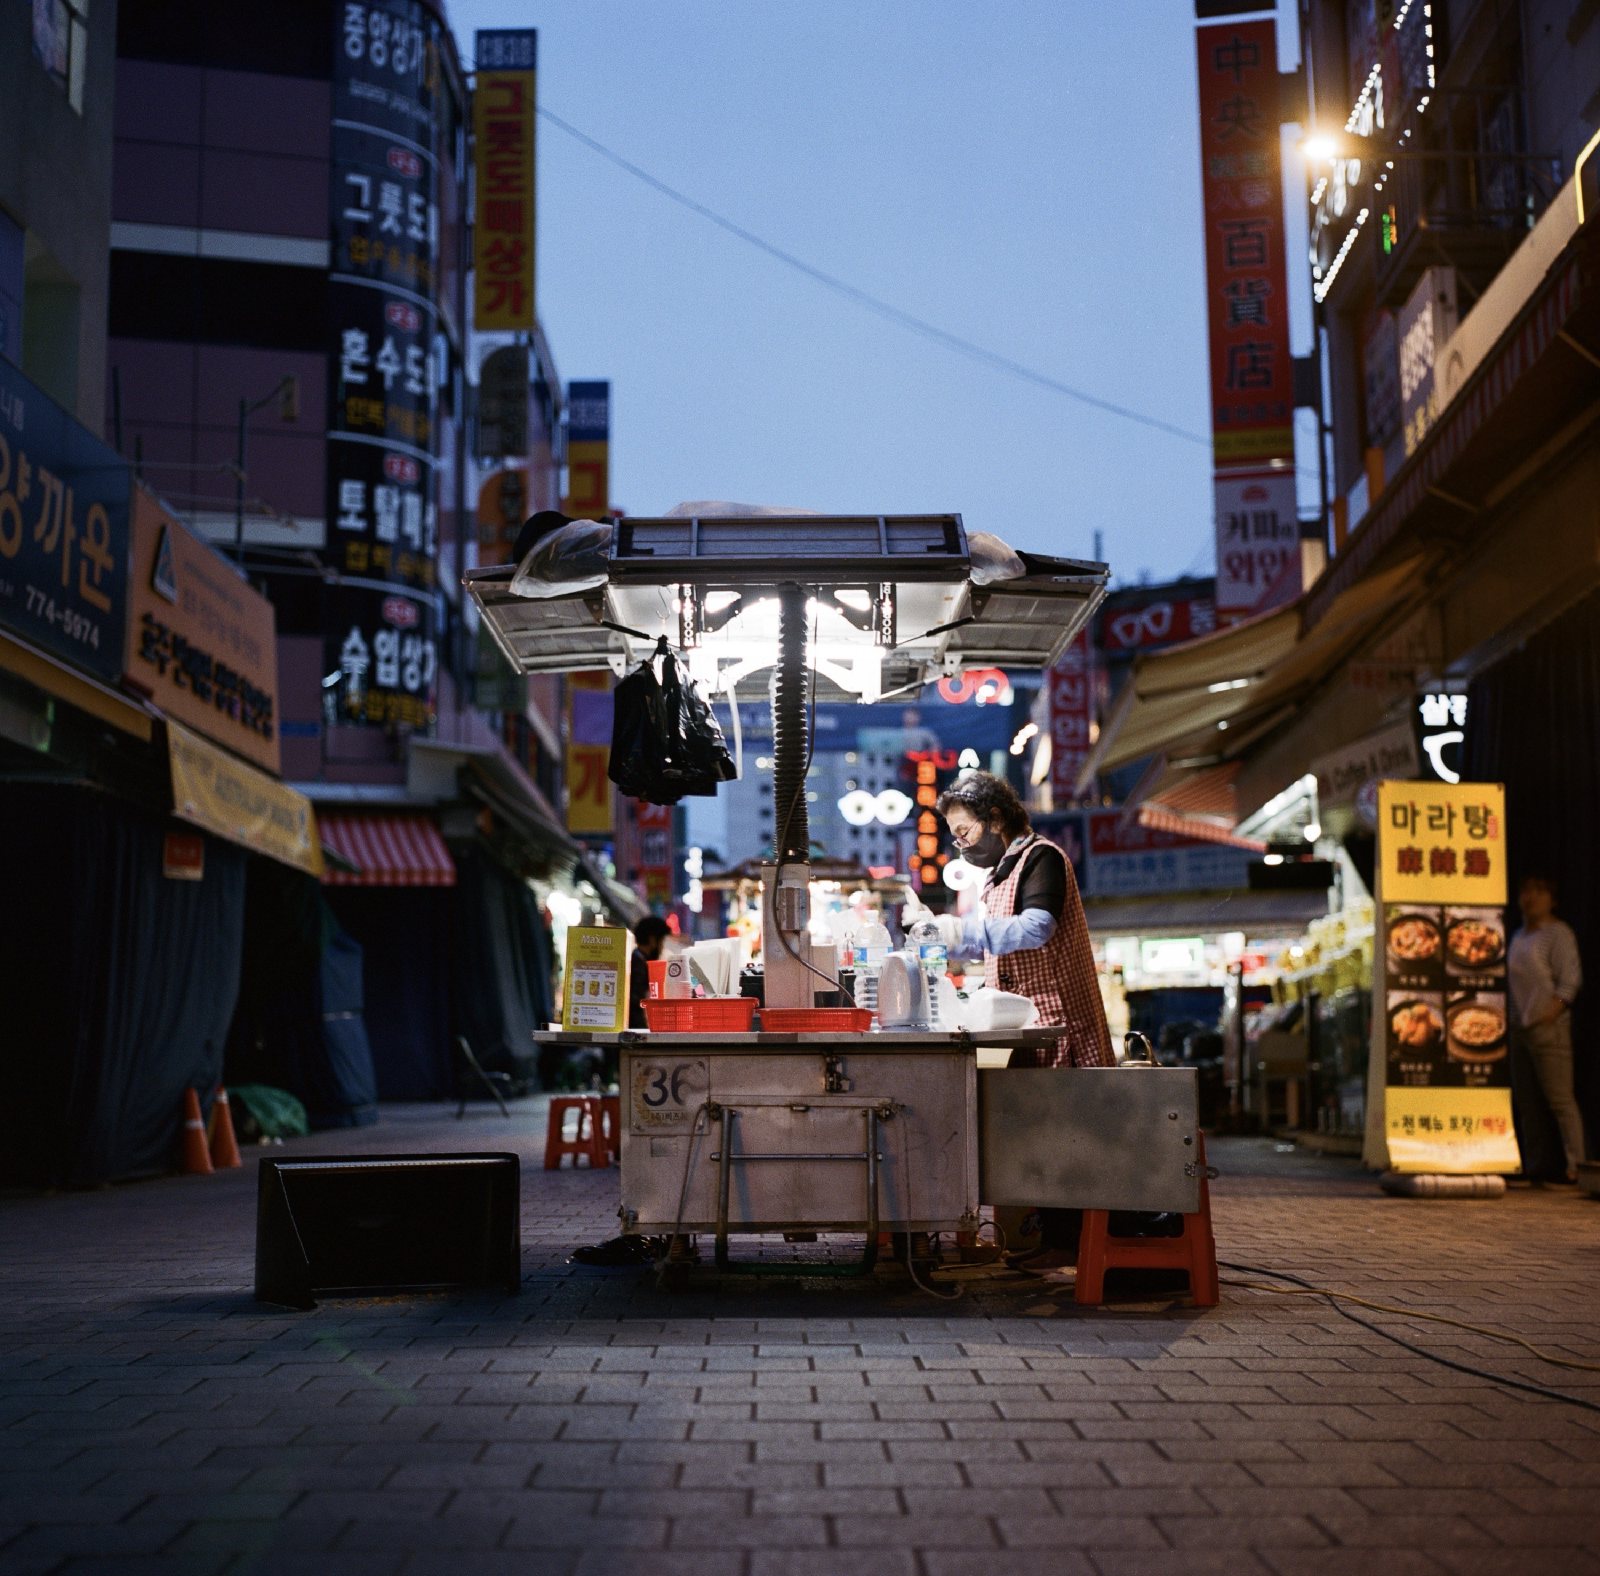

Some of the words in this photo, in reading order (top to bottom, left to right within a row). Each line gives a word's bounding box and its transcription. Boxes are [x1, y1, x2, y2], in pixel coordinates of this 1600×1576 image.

[342, 173, 439, 258] 그릇도
[484, 80, 526, 317] 그릇도매상가
[340, 326, 438, 411] 혼수도
[582, 934, 612, 946] Maxim
